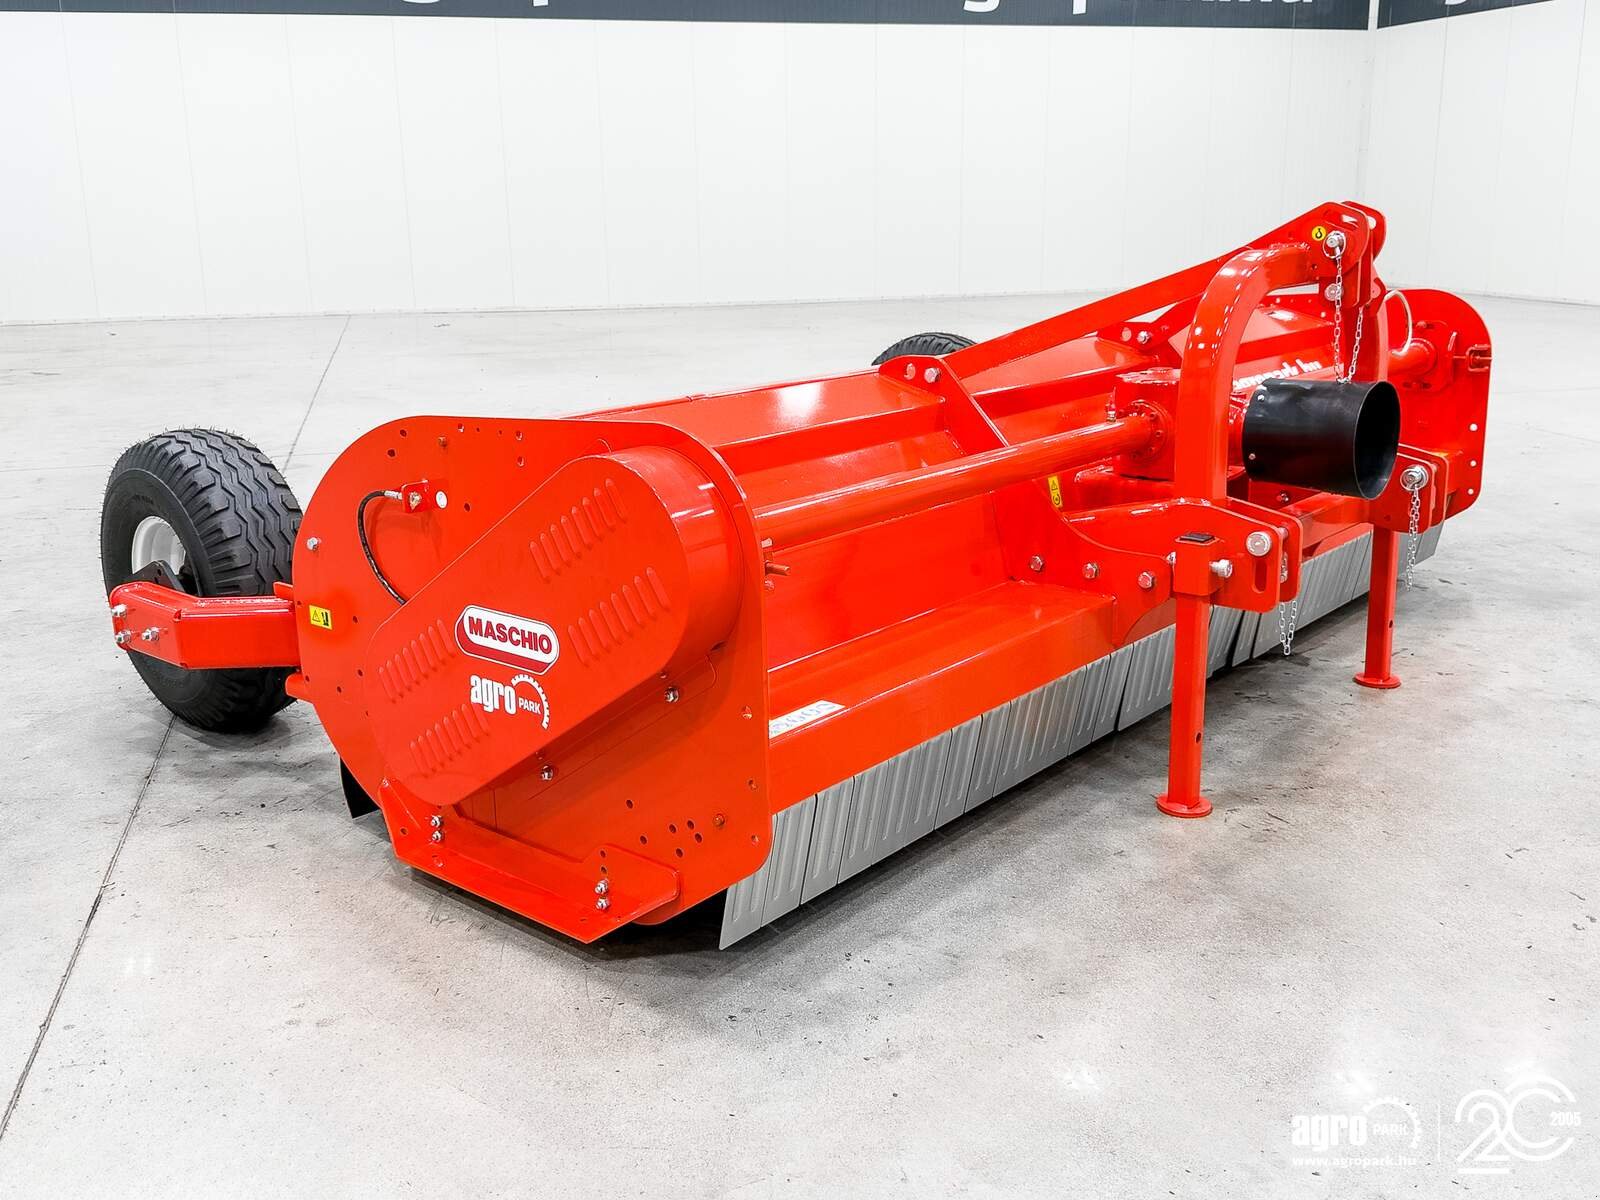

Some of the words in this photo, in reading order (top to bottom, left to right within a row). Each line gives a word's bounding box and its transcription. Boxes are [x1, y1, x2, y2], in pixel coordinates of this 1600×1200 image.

[468, 616, 552, 655] MASCHIO
[470, 675, 516, 715] agro
[518, 697, 542, 715] PARK
